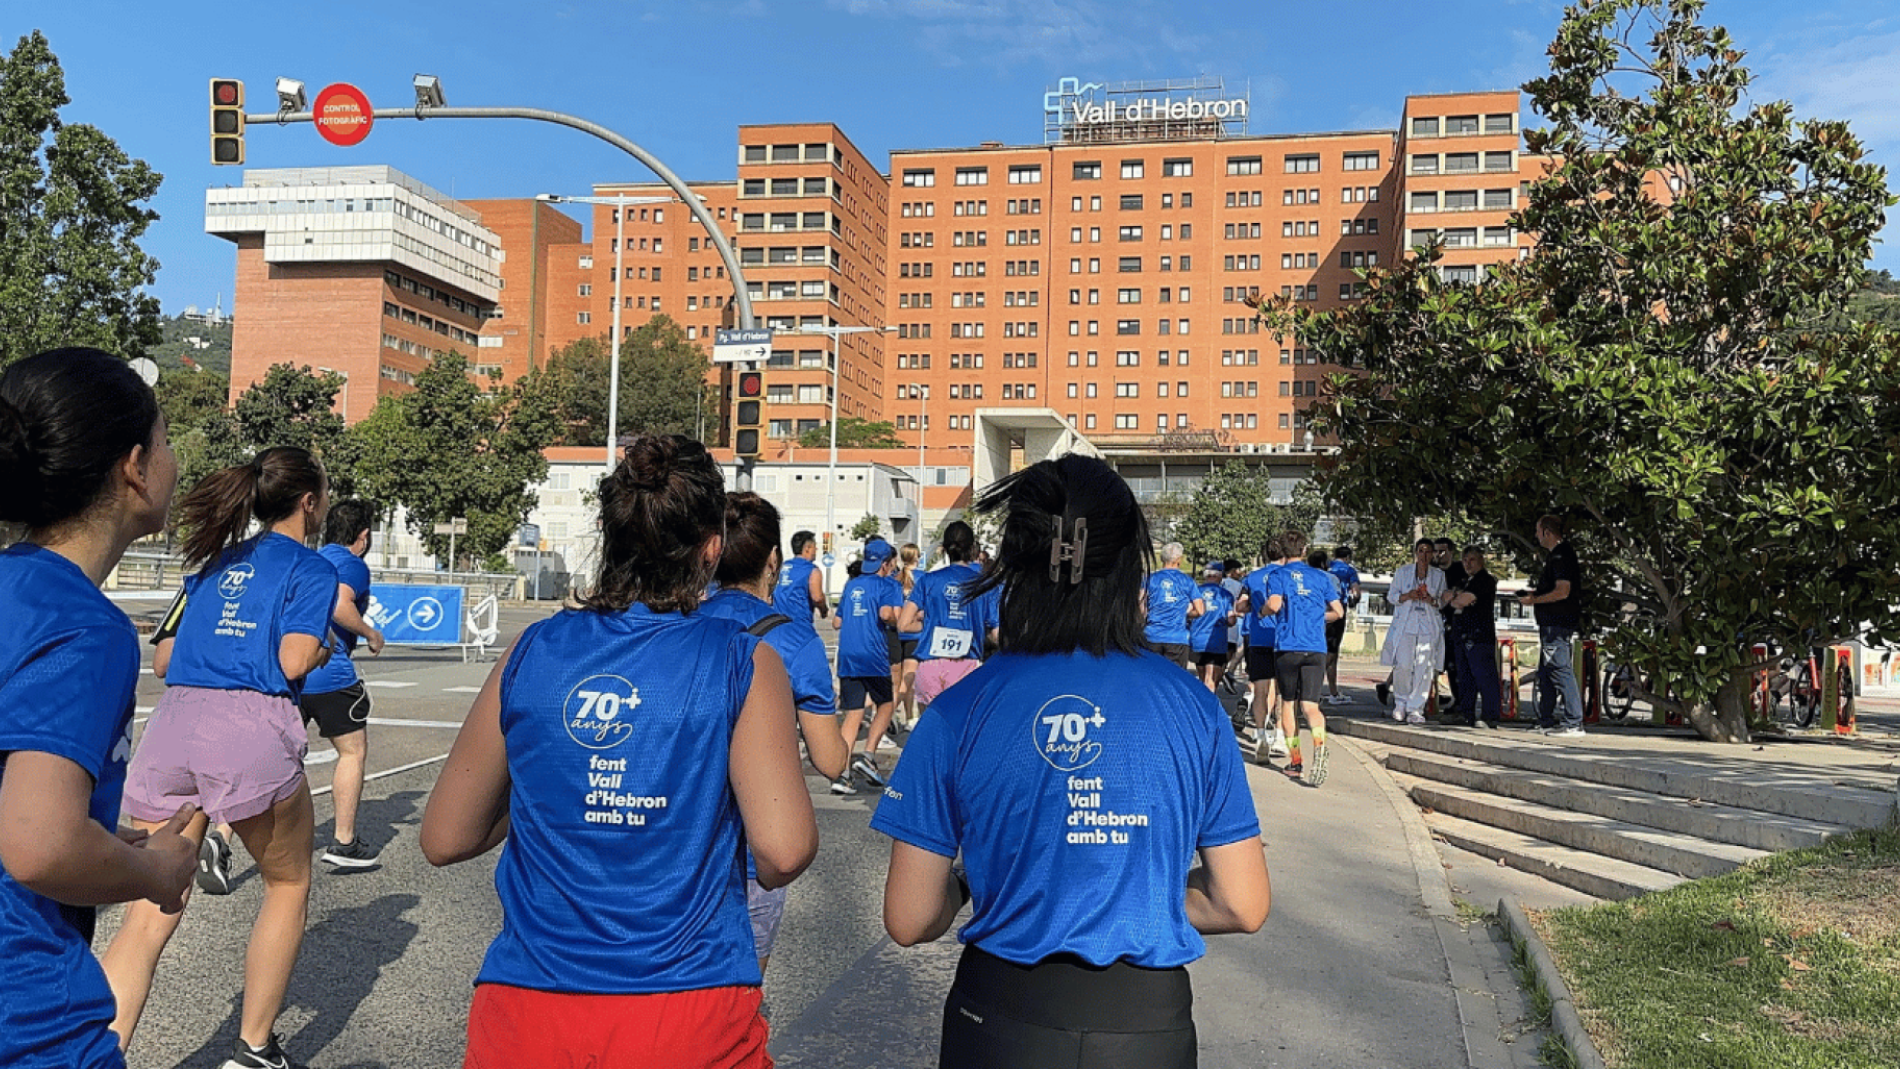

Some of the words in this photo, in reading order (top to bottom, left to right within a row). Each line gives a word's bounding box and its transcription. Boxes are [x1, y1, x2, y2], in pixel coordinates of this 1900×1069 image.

[323, 103, 361, 113] CONTROL
[1072, 100, 1116, 124] Vall
[1125, 97, 1246, 121] d'Hebron
[941, 638, 962, 651] 191
[570, 718, 632, 742] anys
[1045, 739, 1102, 764] anys
[589, 754, 627, 772] fent
[588, 772, 623, 789] Vall
[1067, 775, 1104, 791] fent
[585, 790, 668, 808] d'Hebron
[1067, 792, 1101, 808] Vall
[584, 809, 624, 825] amb
[626, 811, 646, 826] tu
[1067, 810, 1149, 827] d'Hebron
[1066, 828, 1108, 844] amb
[1110, 829, 1130, 844] tu
